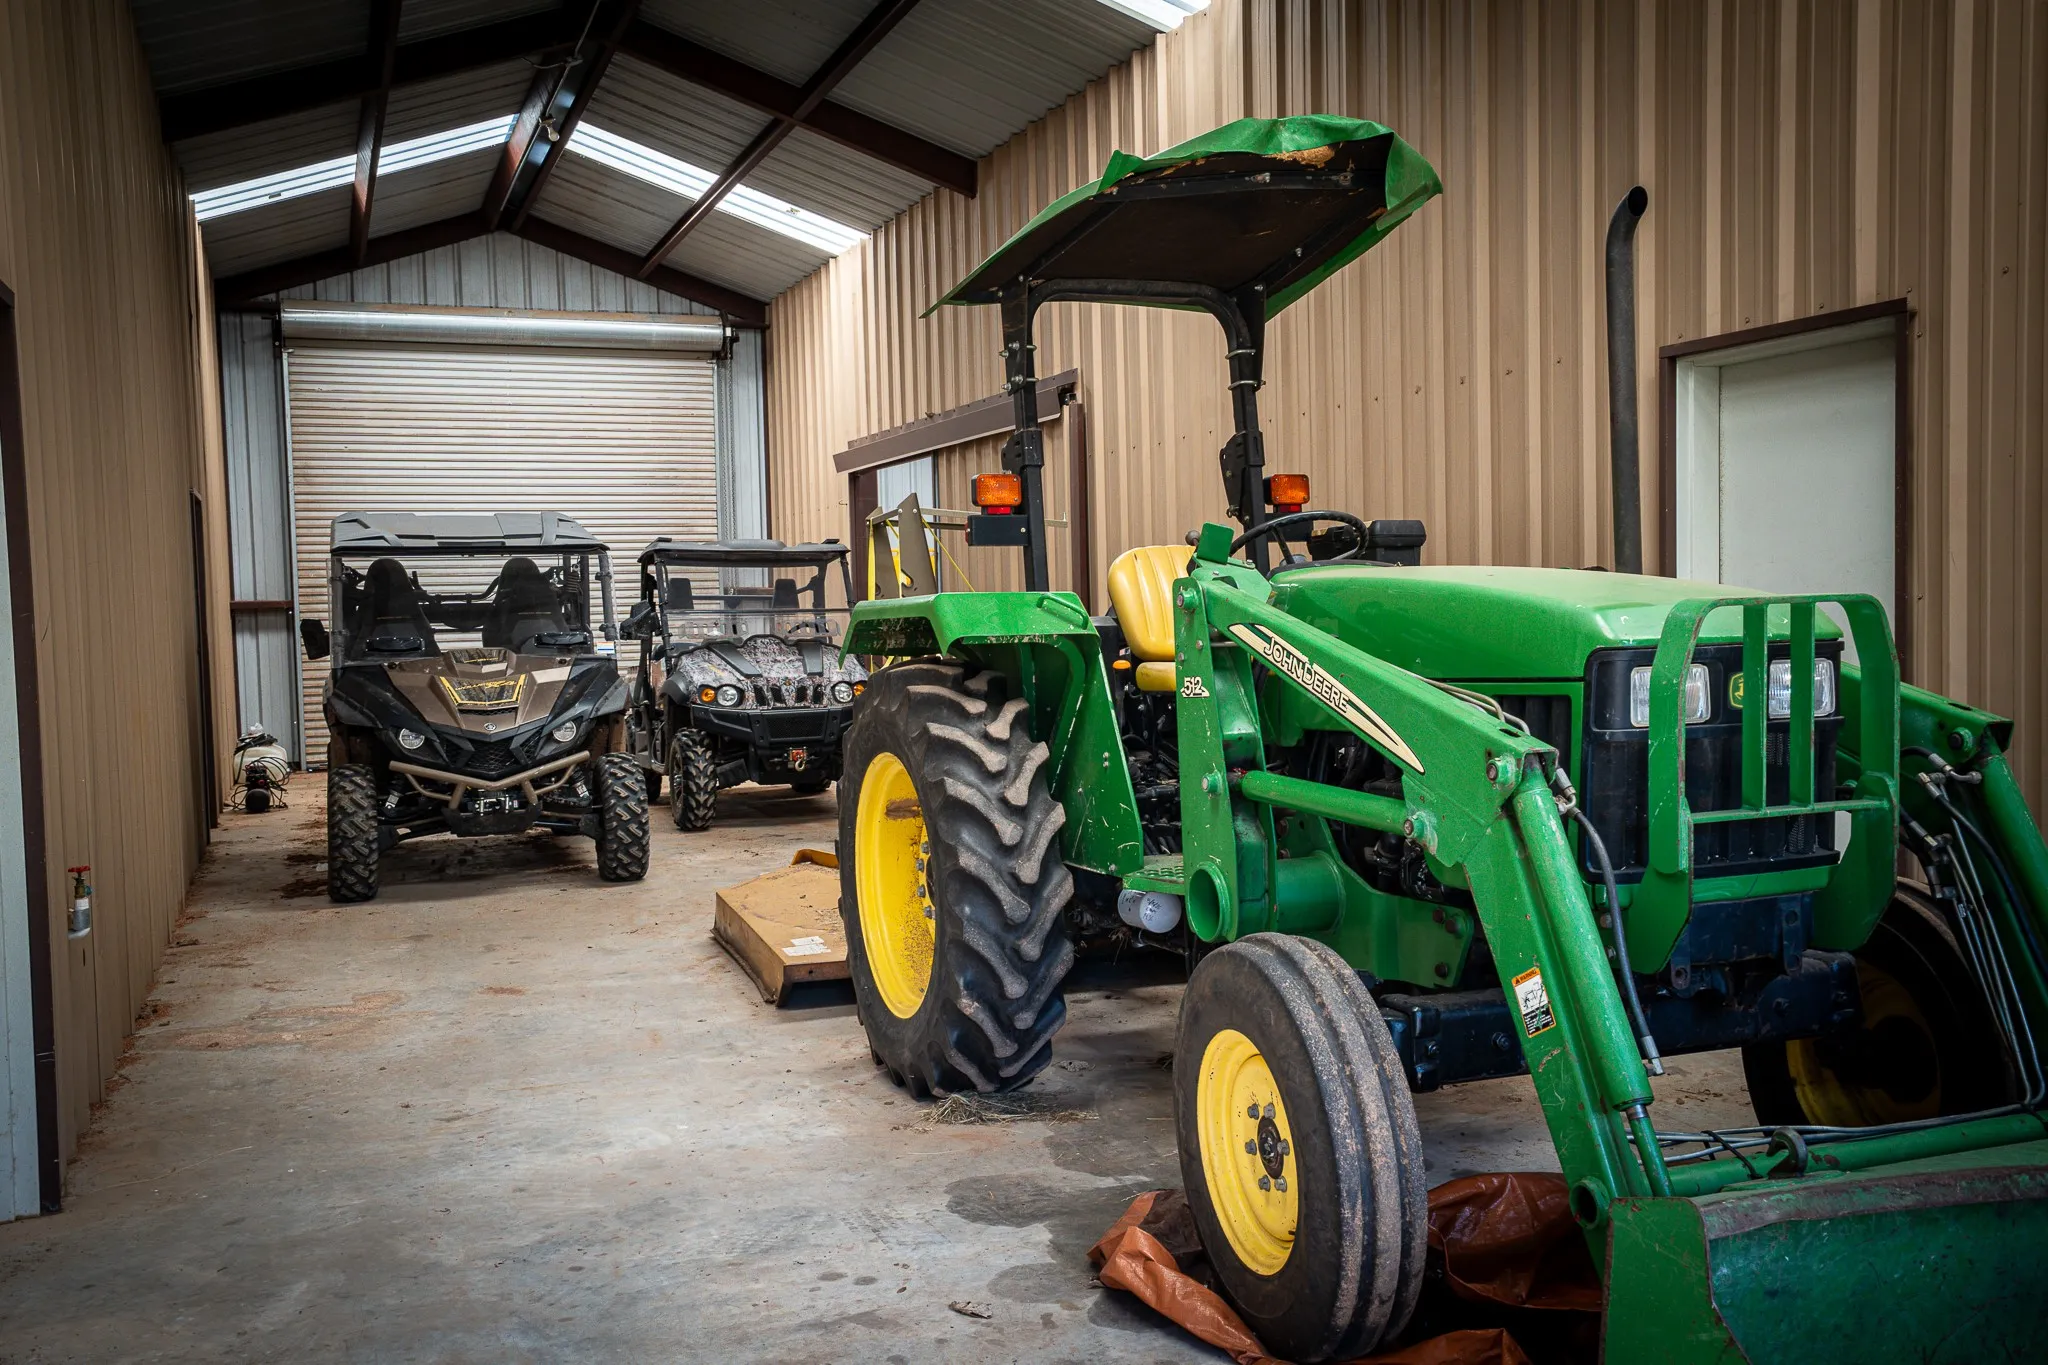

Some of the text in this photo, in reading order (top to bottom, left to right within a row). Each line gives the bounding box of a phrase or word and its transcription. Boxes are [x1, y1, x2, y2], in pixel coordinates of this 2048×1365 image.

[1184, 676, 1202, 696] 512
[1264, 637, 1350, 713] JOHN DEERE
